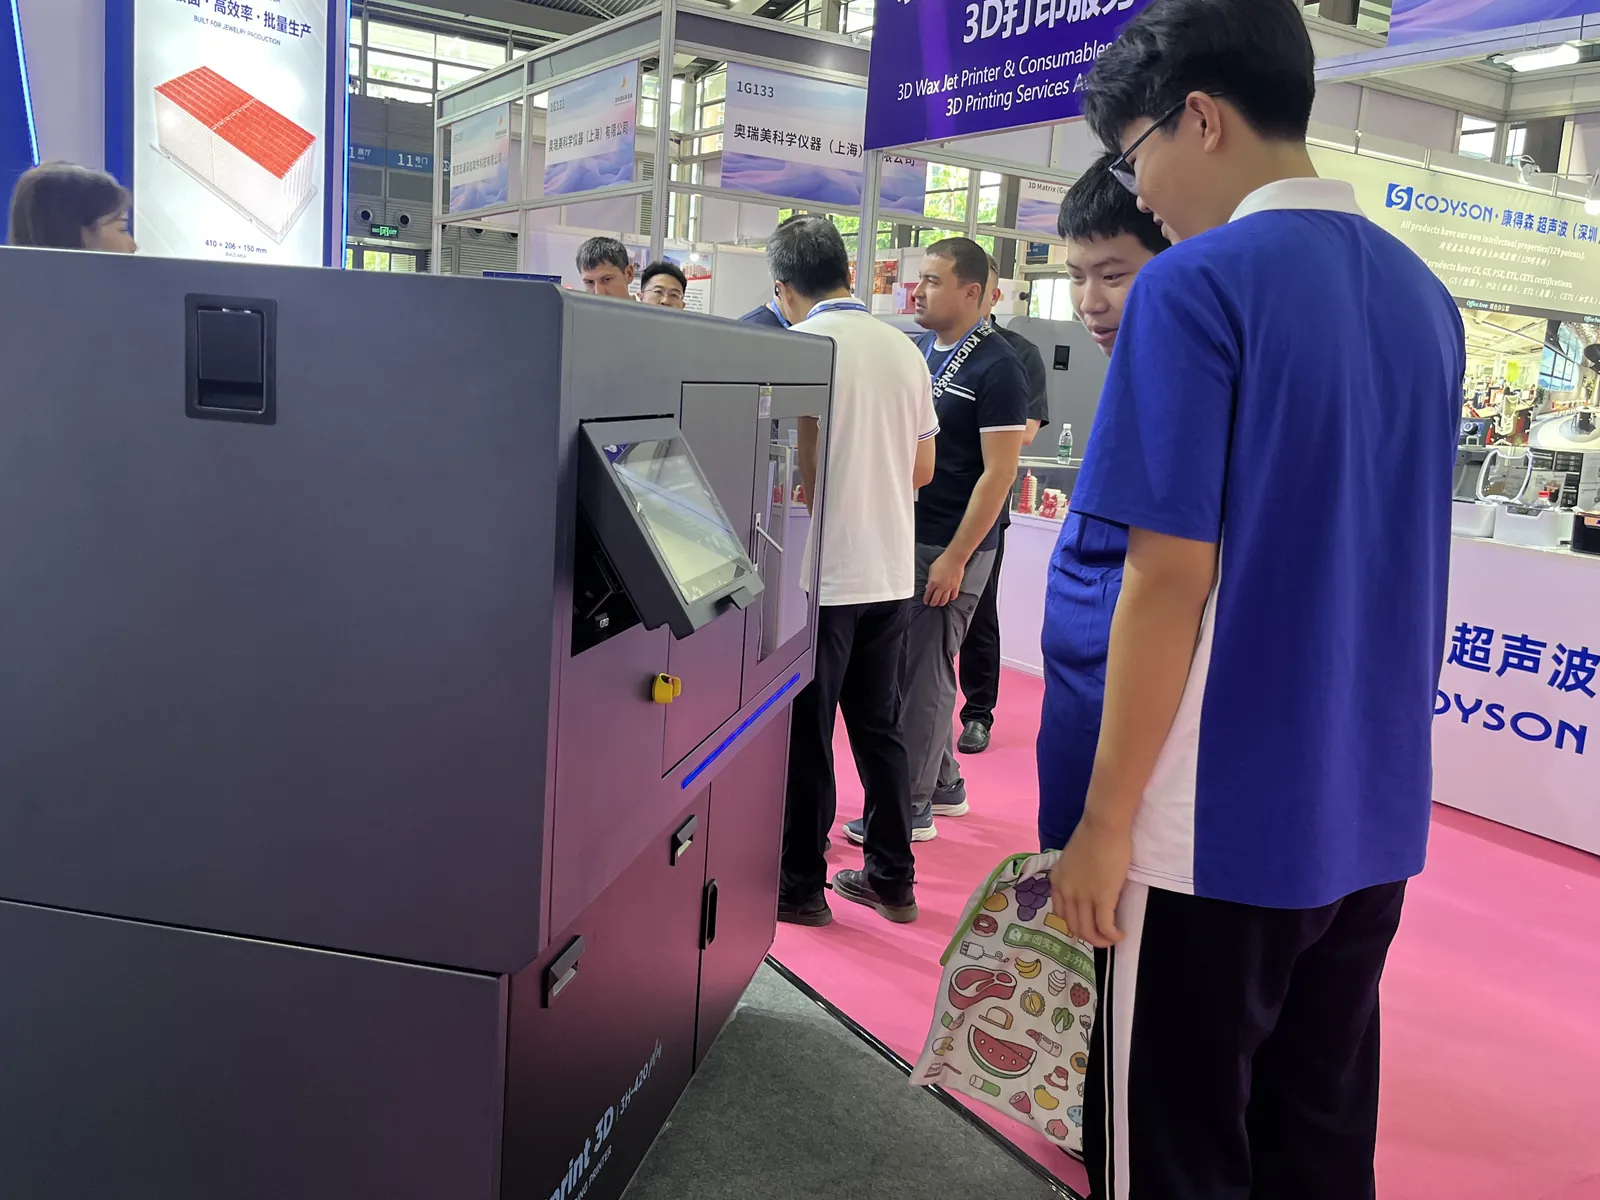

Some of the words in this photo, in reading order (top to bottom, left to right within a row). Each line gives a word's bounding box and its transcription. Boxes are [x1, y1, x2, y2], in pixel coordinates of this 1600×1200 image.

[193, 15, 209, 25] BUILT
[210, 20, 221, 28] FOR
[222, 24, 246, 36] JEWELRY
[247, 31, 281, 46] PRODUCTION
[737, 80, 775, 98] 1G133
[897, 82, 912, 101] 3D
[915, 77, 940, 97] Wax
[942, 74, 958, 92] Jet
[961, 66, 1001, 87] Printer
[1003, 59, 1015, 78] &
[945, 97, 963, 116] 3D
[965, 90, 1012, 110] Printing
[1016, 78, 1070, 103] Services
[398, 153, 413, 167] 11
[1028, 181, 1036, 189] 3D
[1037, 183, 1057, 193] Matrix
[205, 239, 217, 247] 410
[225, 242, 236, 250] 206
[244, 244, 254, 252] 150
[1400, 219, 1410, 230] All
[1411, 223, 1440, 237] products
[1441, 226, 1456, 239] have
[1457, 230, 1468, 240] our
[1468, 232, 1482, 243] own
[1482, 233, 1518, 248] intellectual
[1427, 260, 1456, 271] products
[1456, 264, 1472, 274] have
[1447, 621, 1600, 699] 超声波
[593, 1105, 614, 1153] 3D
